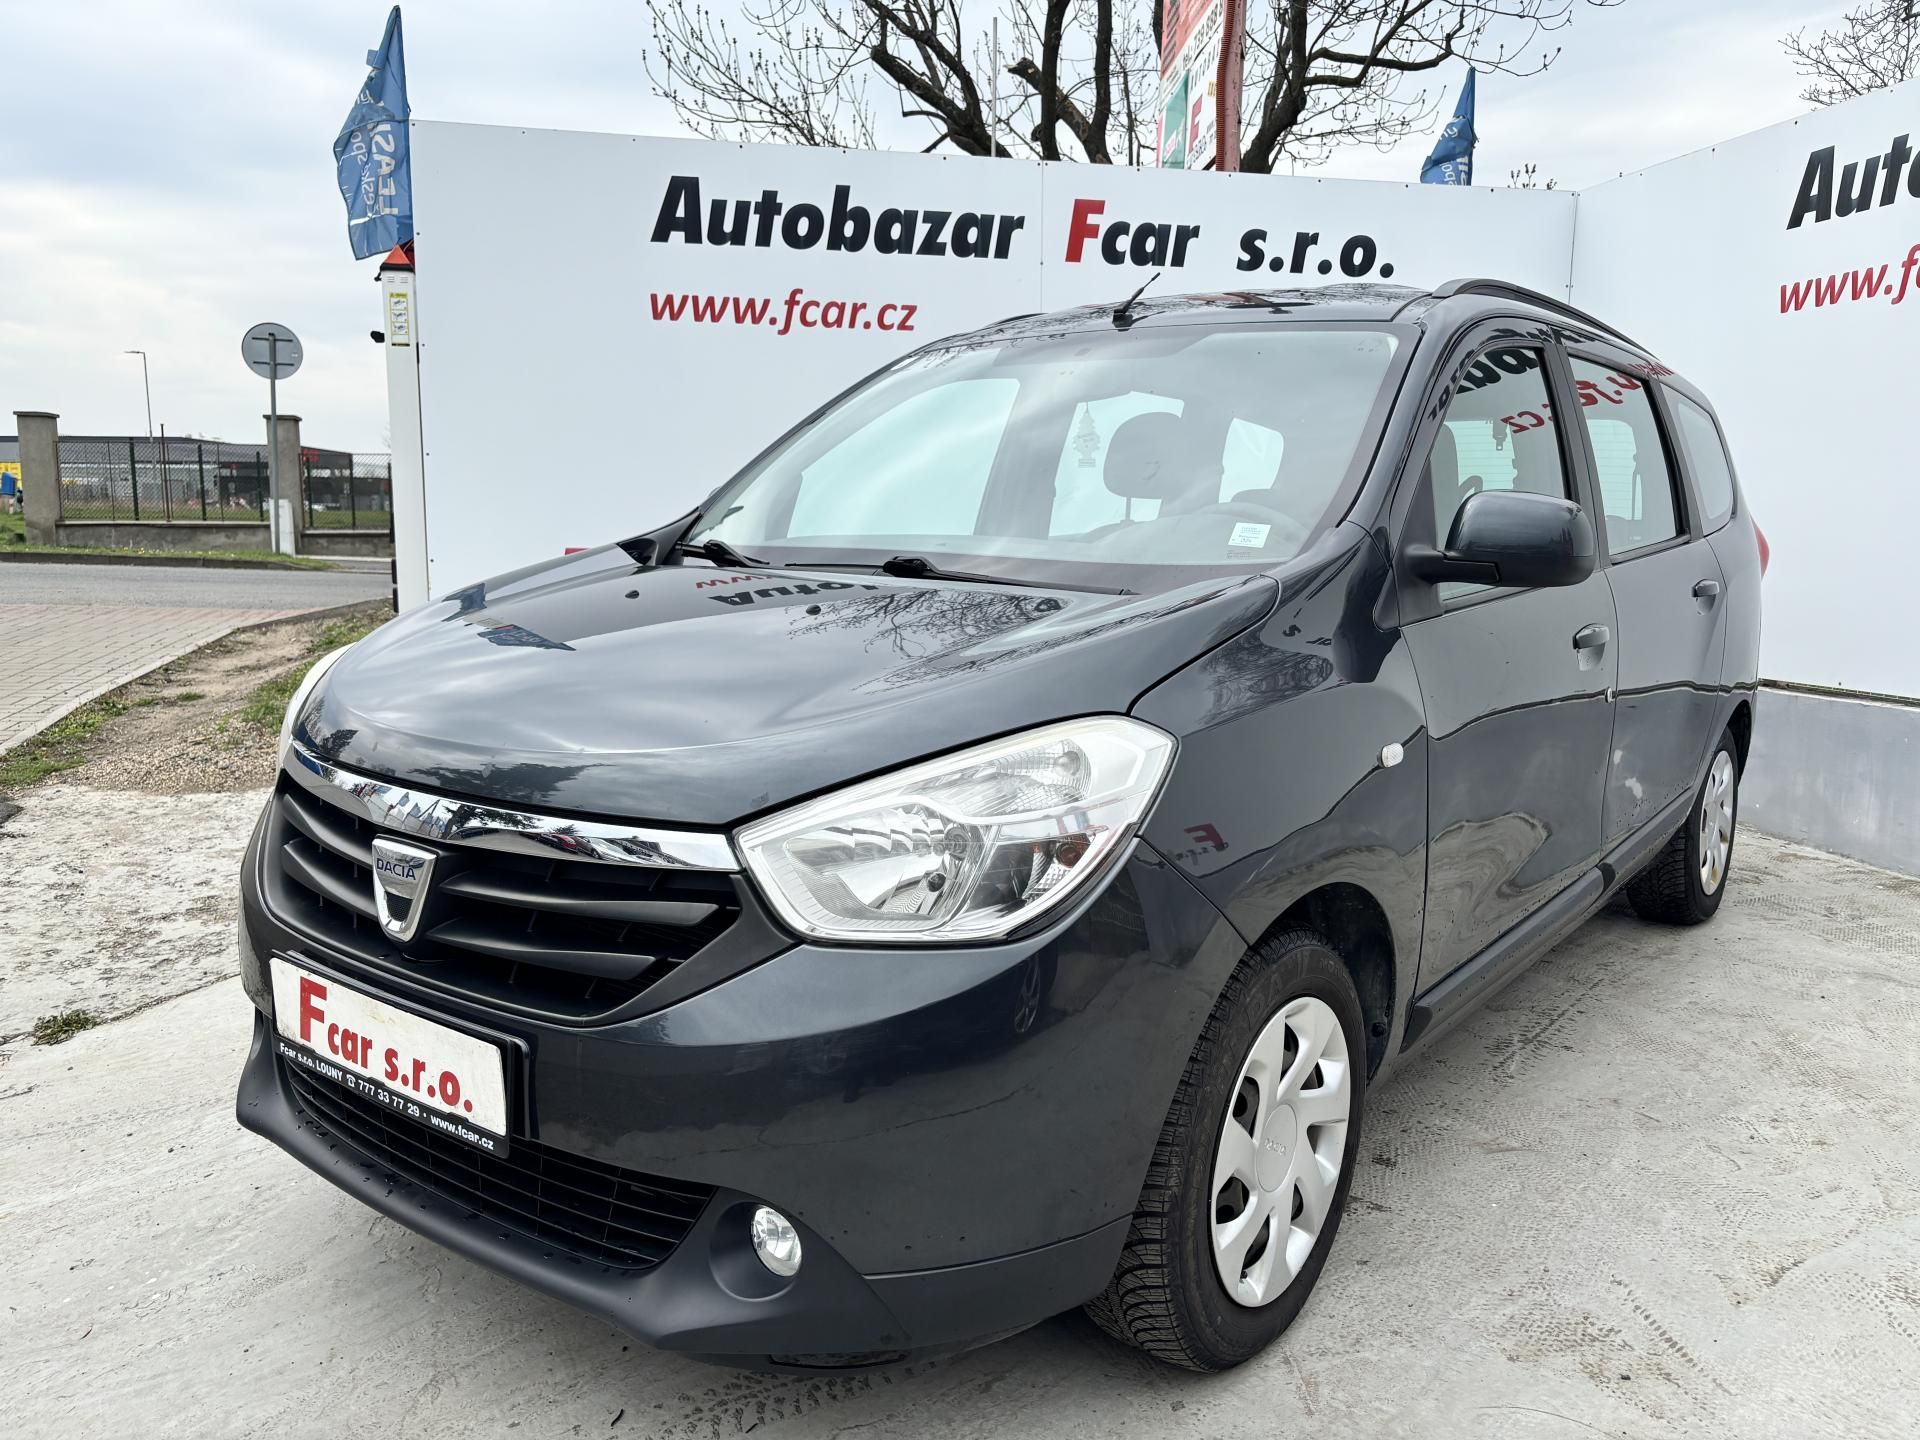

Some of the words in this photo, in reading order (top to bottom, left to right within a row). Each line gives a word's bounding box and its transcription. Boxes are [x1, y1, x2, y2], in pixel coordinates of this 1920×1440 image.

[650, 175, 1025, 260] Autobazar
[1065, 198, 1200, 268] Fcar
[1236, 228, 1394, 279] s.r.o.
[650, 288, 918, 336] www.fcar.cz
[1780, 244, 1920, 314] www.f
[376, 857, 416, 881] DACIA
[299, 976, 373, 1069] Fcar
[384, 1048, 473, 1112] s.r.o.
[280, 1042, 296, 1059] Fcar
[316, 1060, 343, 1081] LOUNY
[358, 1079, 375, 1096] 777
[377, 1089, 390, 1103] 33
[391, 1095, 404, 1110] 77
[407, 1102, 420, 1117] 29
[430, 1115, 494, 1150] www.fcar.cz
